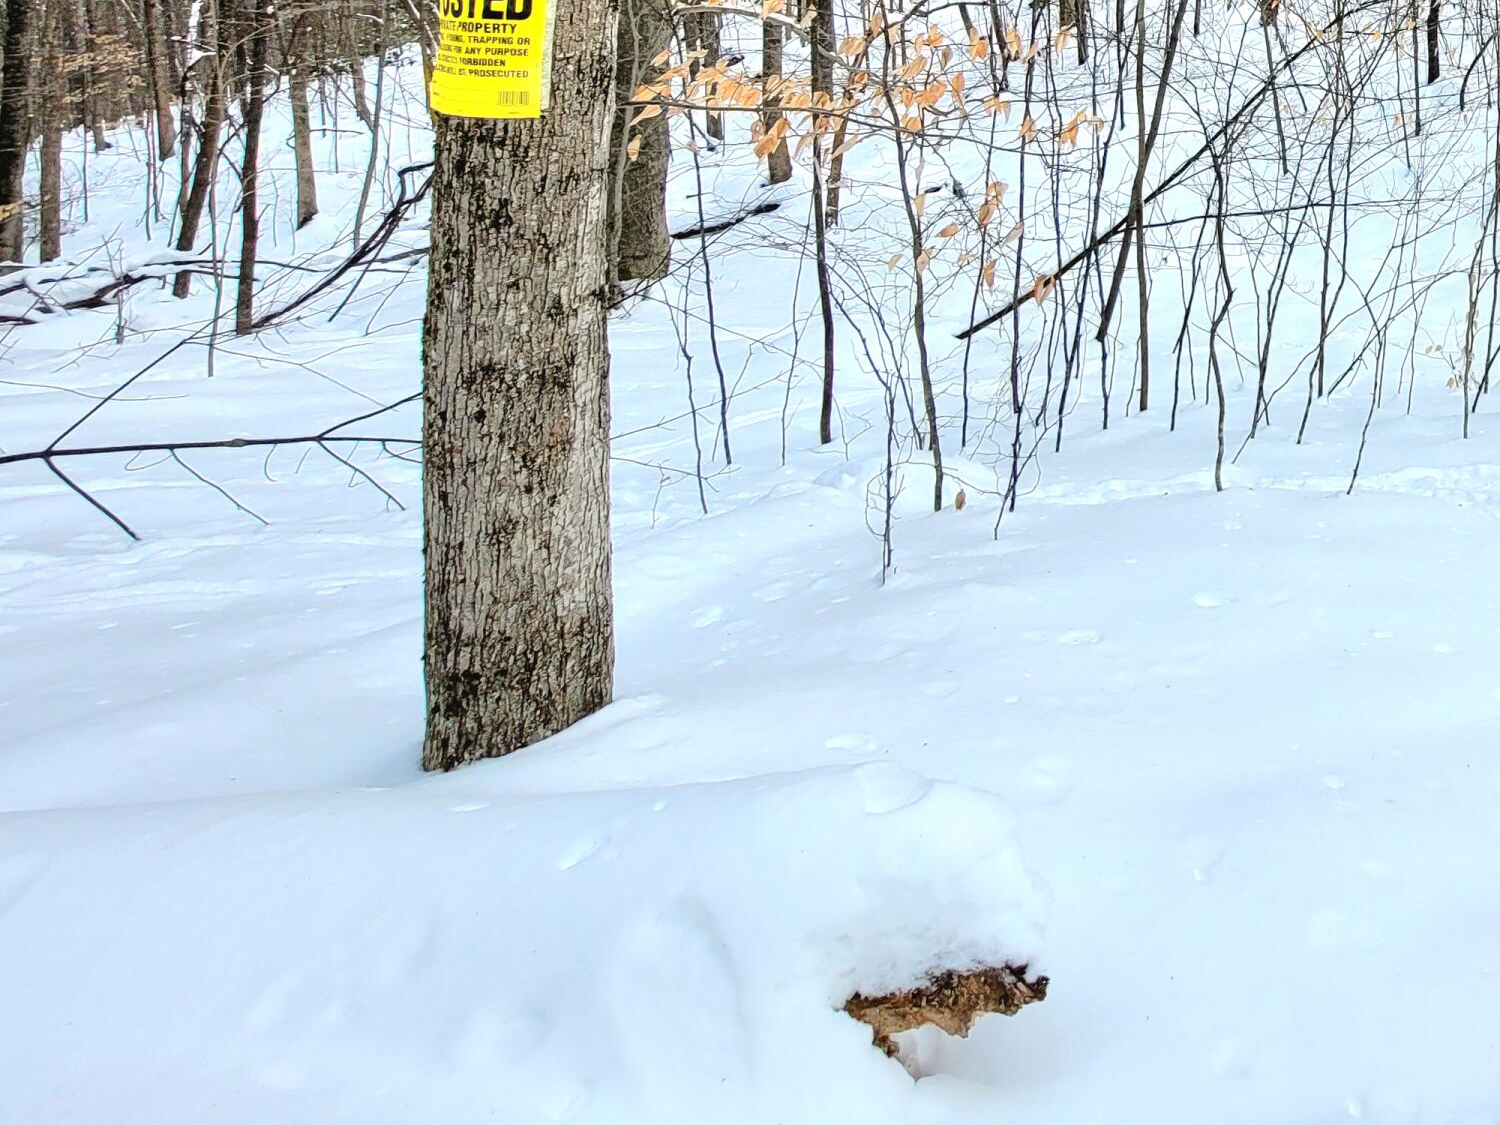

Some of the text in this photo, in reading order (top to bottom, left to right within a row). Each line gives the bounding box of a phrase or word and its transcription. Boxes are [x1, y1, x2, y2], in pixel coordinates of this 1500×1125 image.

[457, 21, 517, 33] PROPERTY
[468, 36, 513, 45] TRAPPING
[517, 37, 530, 45] OR
[465, 47, 481, 55] ANY
[485, 48, 529, 56] PURPOSE
[459, 57, 506, 66] FORBIDDEN
[469, 69, 529, 78] PROSECUTED
